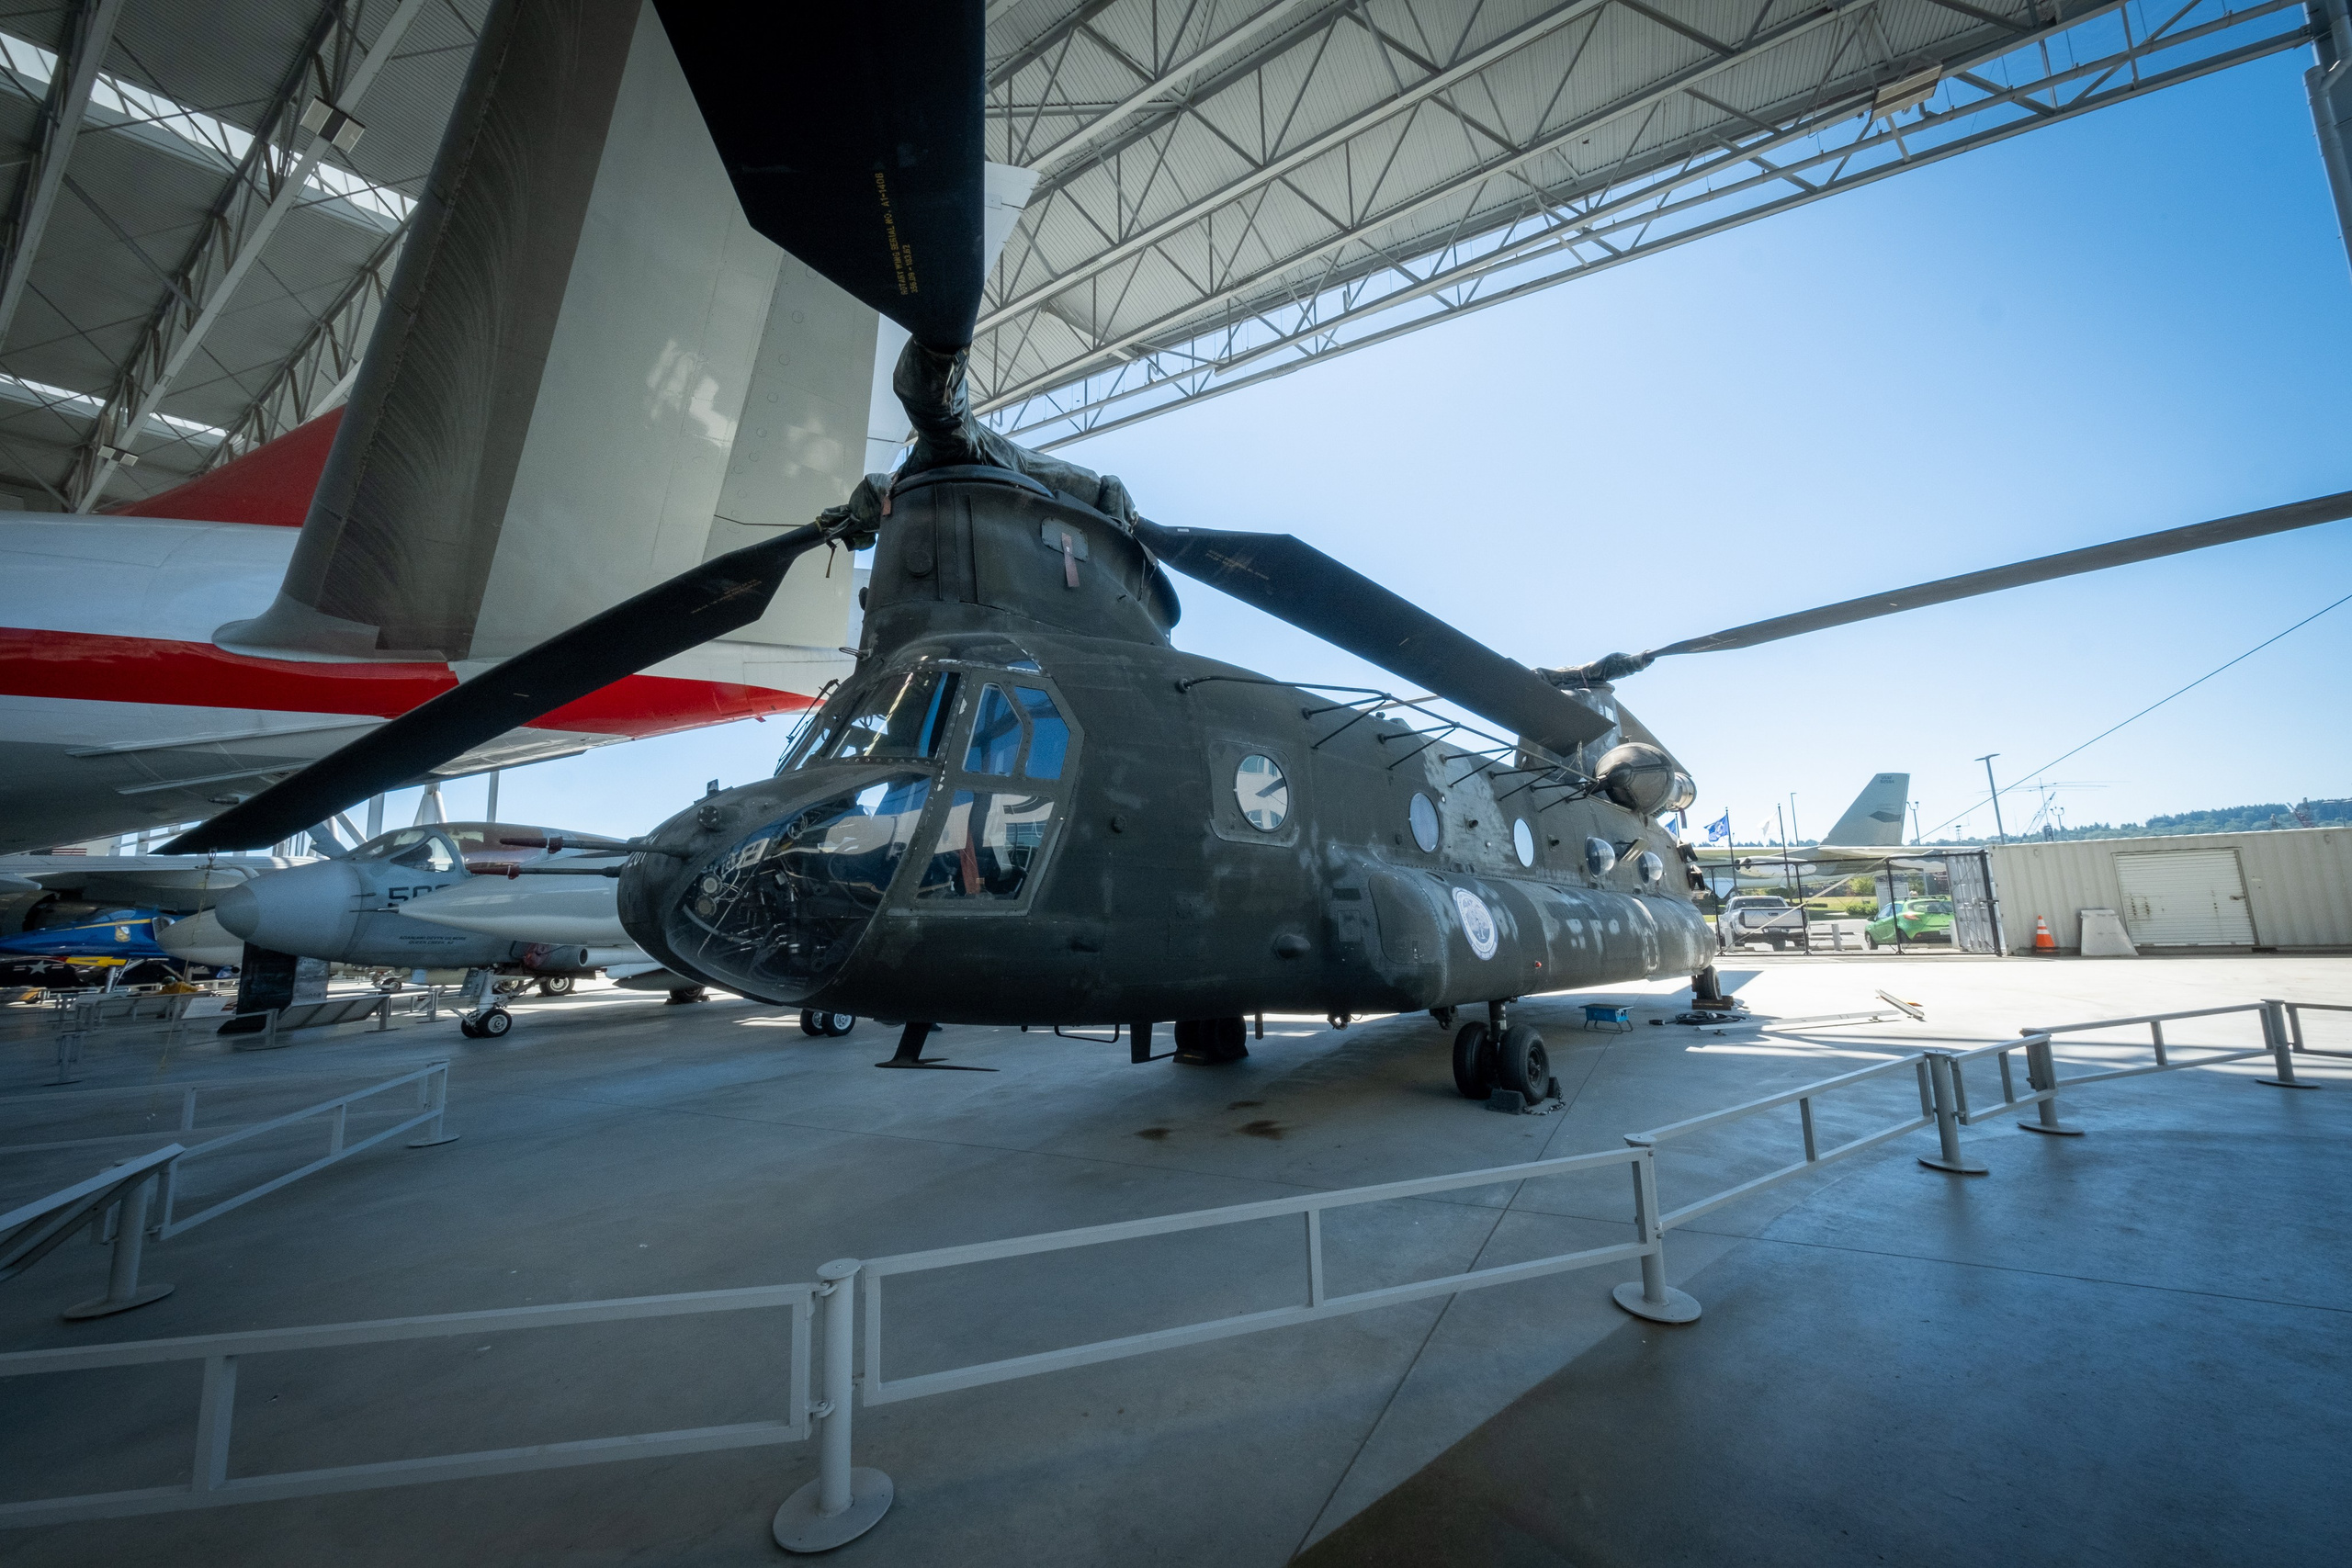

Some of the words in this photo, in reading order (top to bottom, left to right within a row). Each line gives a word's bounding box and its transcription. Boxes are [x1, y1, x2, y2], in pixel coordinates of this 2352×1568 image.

[884, 209, 894, 224] NO.
[888, 226, 899, 250] SERIAL
[893, 252, 903, 270] WING
[897, 271, 908, 295] ROTARY
